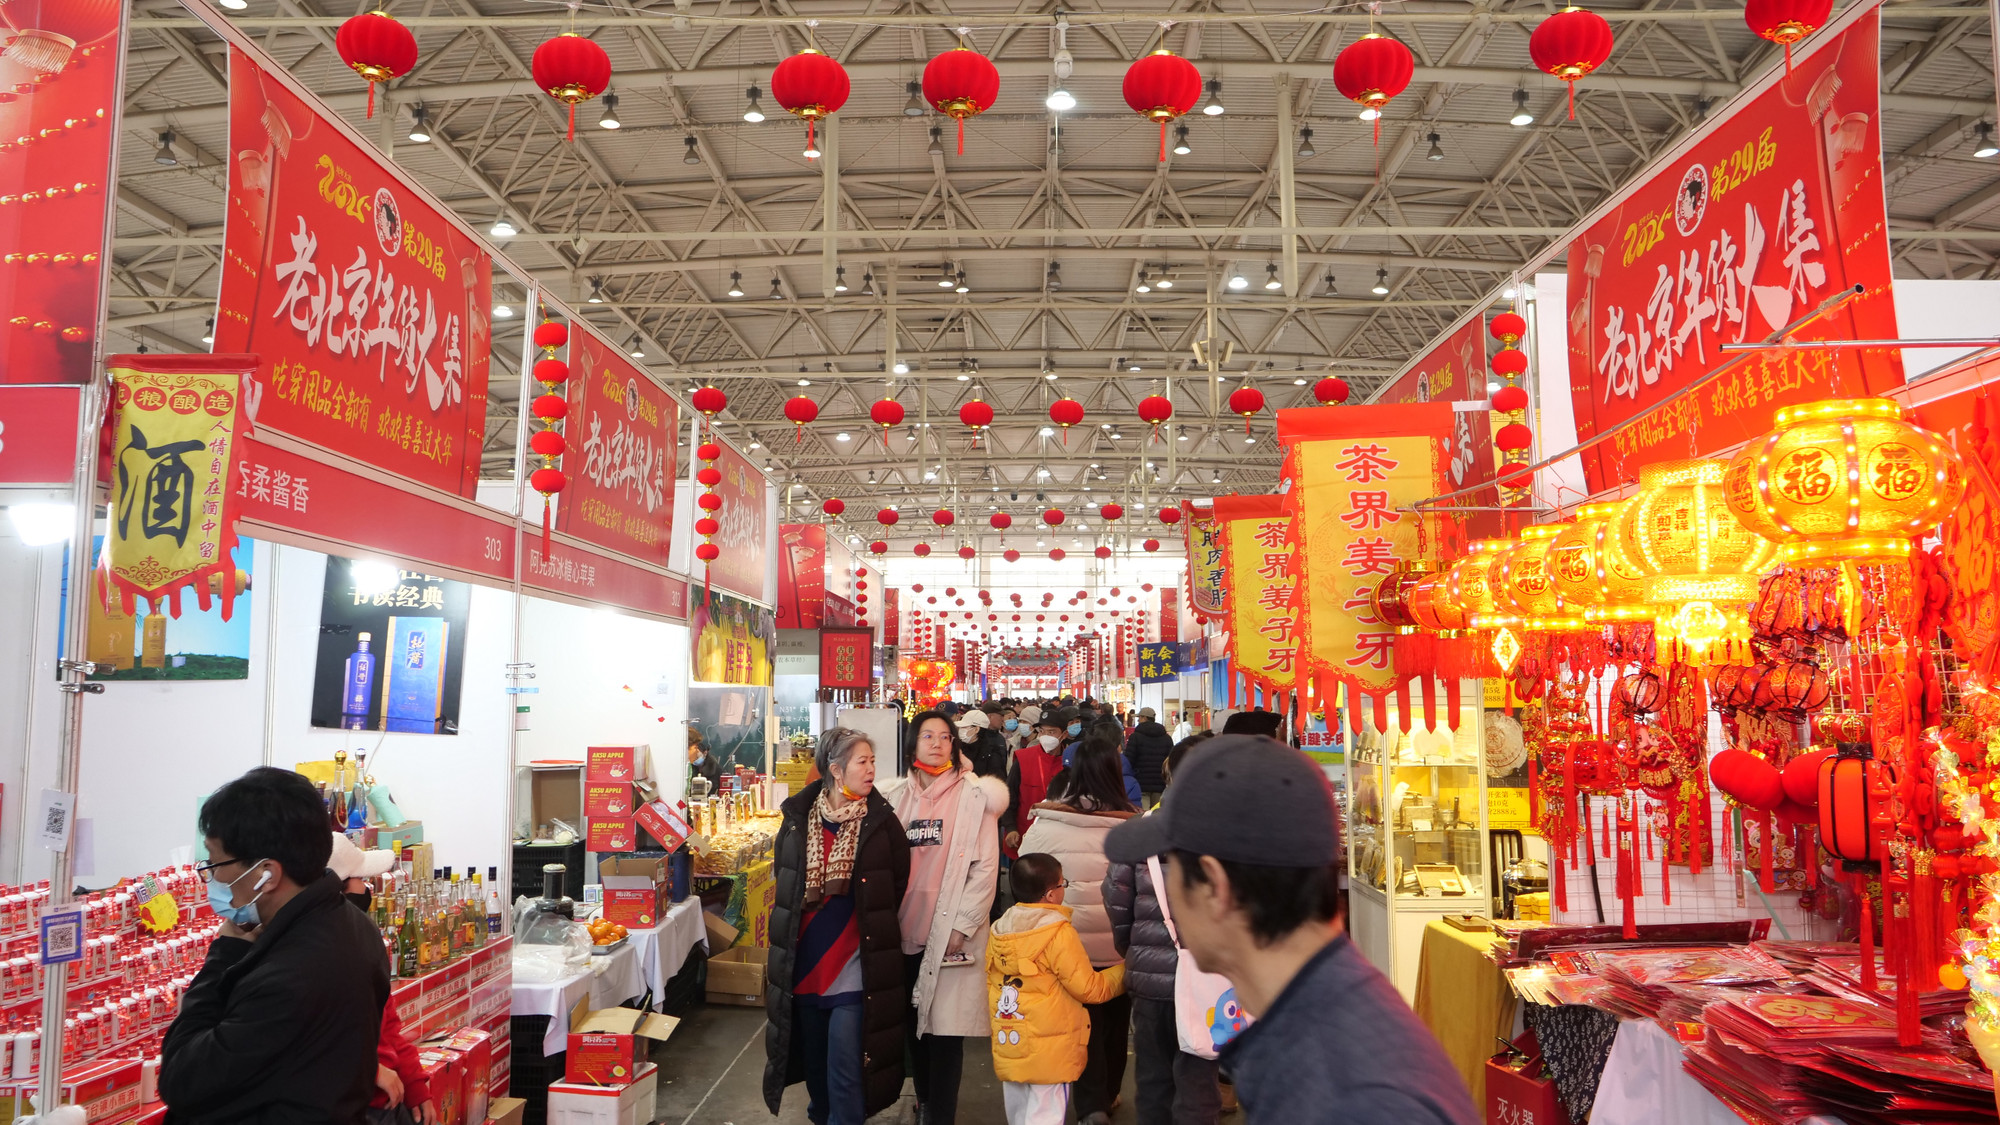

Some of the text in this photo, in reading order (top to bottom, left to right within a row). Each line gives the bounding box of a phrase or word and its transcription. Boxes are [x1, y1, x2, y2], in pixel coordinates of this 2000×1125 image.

[1710, 126, 1777, 203] 第29届
[403, 220, 446, 281] 第29届
[272, 215, 463, 411] 老北京年货大集
[1598, 179, 1826, 404] 老北京年货大集
[272, 356, 453, 467] 吃穿用品全都有 欢欢喜喜过大年
[638, 396, 658, 428] 第29届
[582, 410, 664, 513] 老北京年货大集
[1784, 450, 1831, 500] 福
[1875, 447, 1921, 495] 福
[118, 424, 206, 549] 酒
[199, 420, 232, 559] 人情自在酒中留
[484, 536, 502, 562] 303
[529, 548, 596, 587] 阿克苏冰糖心苹果
[1560, 547, 1587, 579] 福
[1464, 572, 1484, 597] 福
[1517, 561, 1546, 592] 福
[1140, 645, 1175, 661] 新会
[1142, 663, 1177, 678] 陈皮
[1497, 1097, 1535, 1125] 灭火器
